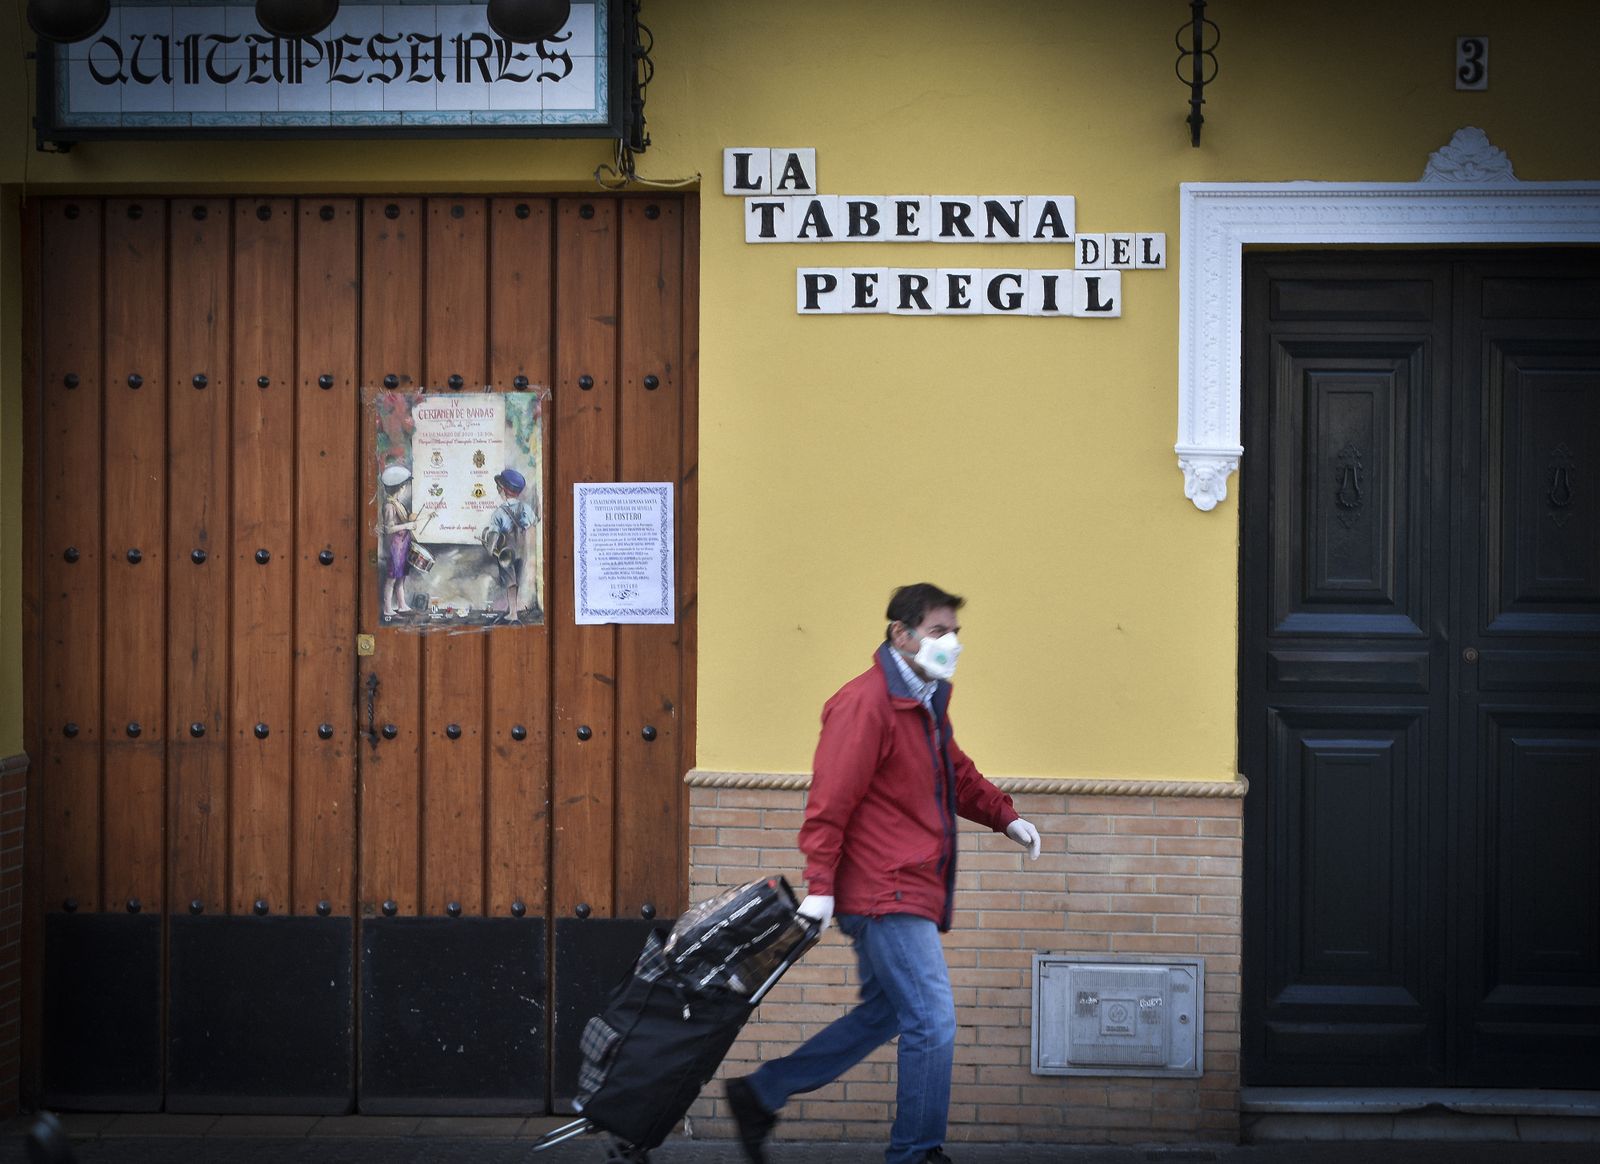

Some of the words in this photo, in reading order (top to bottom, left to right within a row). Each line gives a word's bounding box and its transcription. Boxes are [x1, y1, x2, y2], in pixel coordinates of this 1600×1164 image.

[88, 30, 573, 86] QUITAPESARES
[1459, 39, 1484, 84] 3
[732, 152, 811, 191] LA
[752, 199, 1070, 239] TABERNA
[1081, 237, 1161, 265] DEL
[803, 272, 1113, 312] PEREGIL
[418, 409, 455, 420] CERTAMEN
[456, 409, 465, 419] DE
[466, 408, 494, 419] BANDAS
